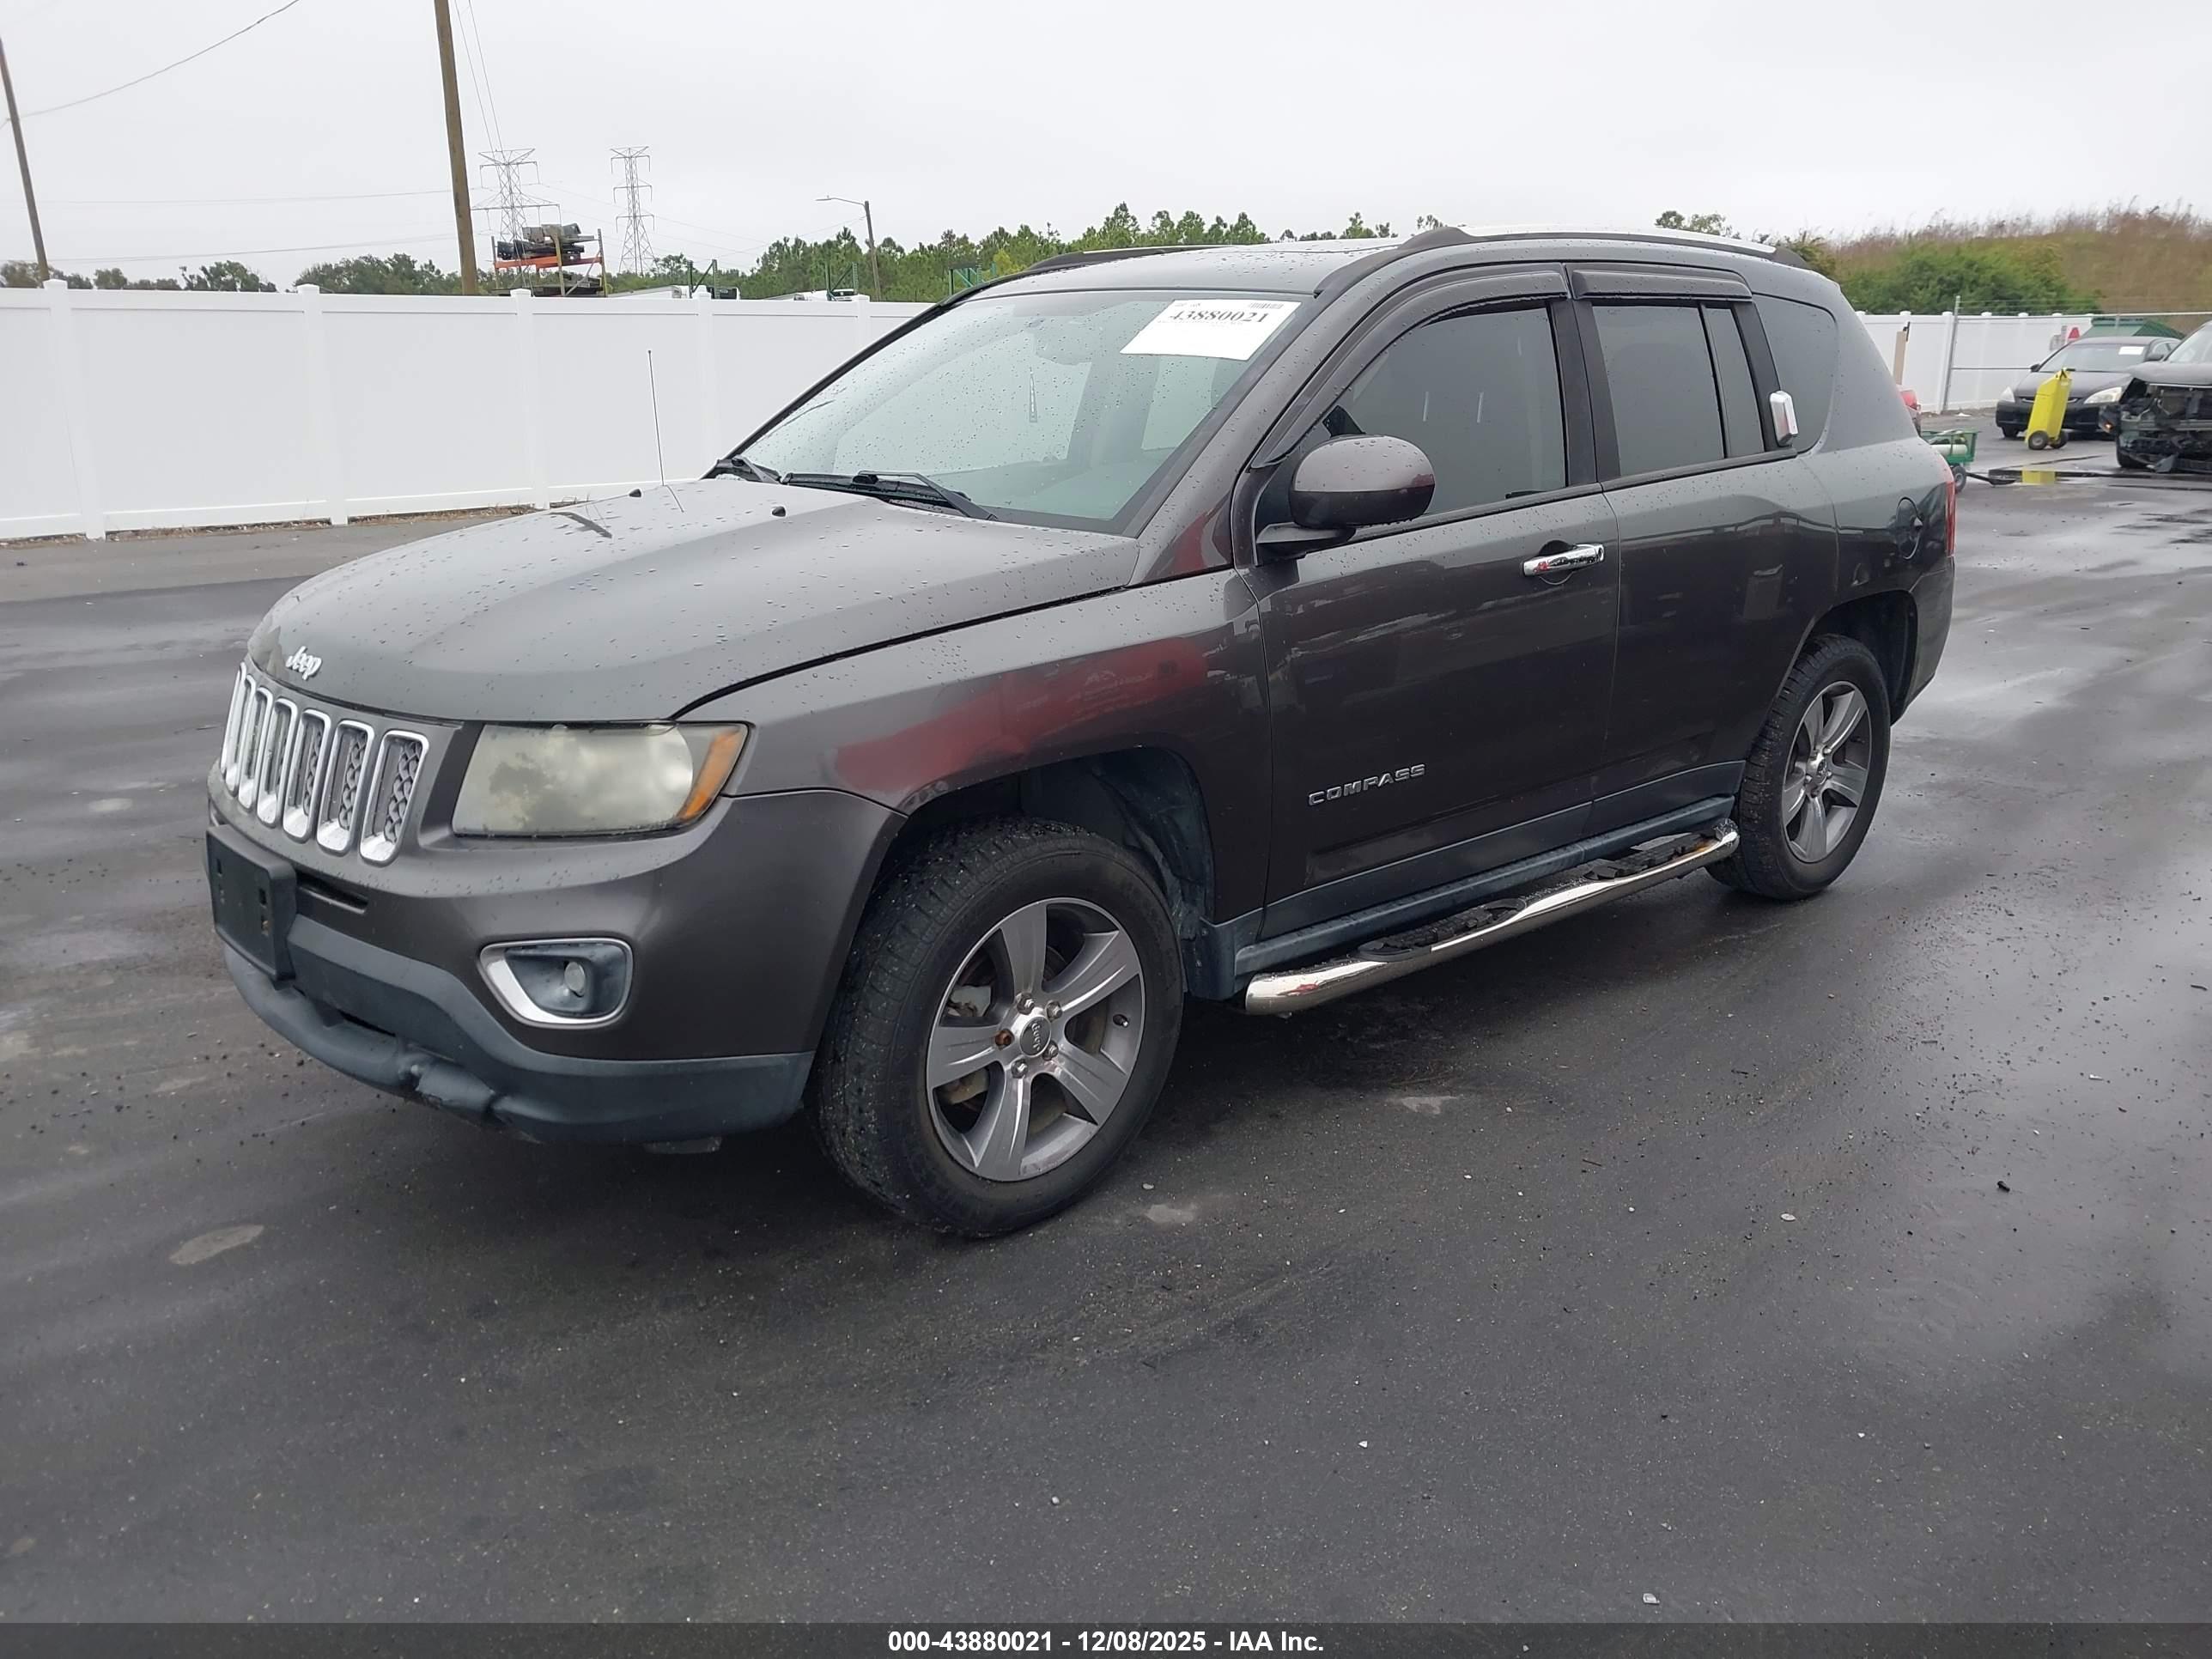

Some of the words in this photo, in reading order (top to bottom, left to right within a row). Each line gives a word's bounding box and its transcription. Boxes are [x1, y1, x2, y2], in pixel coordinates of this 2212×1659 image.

[1170, 310, 1269, 323] 43880021
[285, 645, 322, 680] Jeep
[1309, 763, 1425, 805] COMPASS
[1031, 1023, 1042, 1051] Jeep
